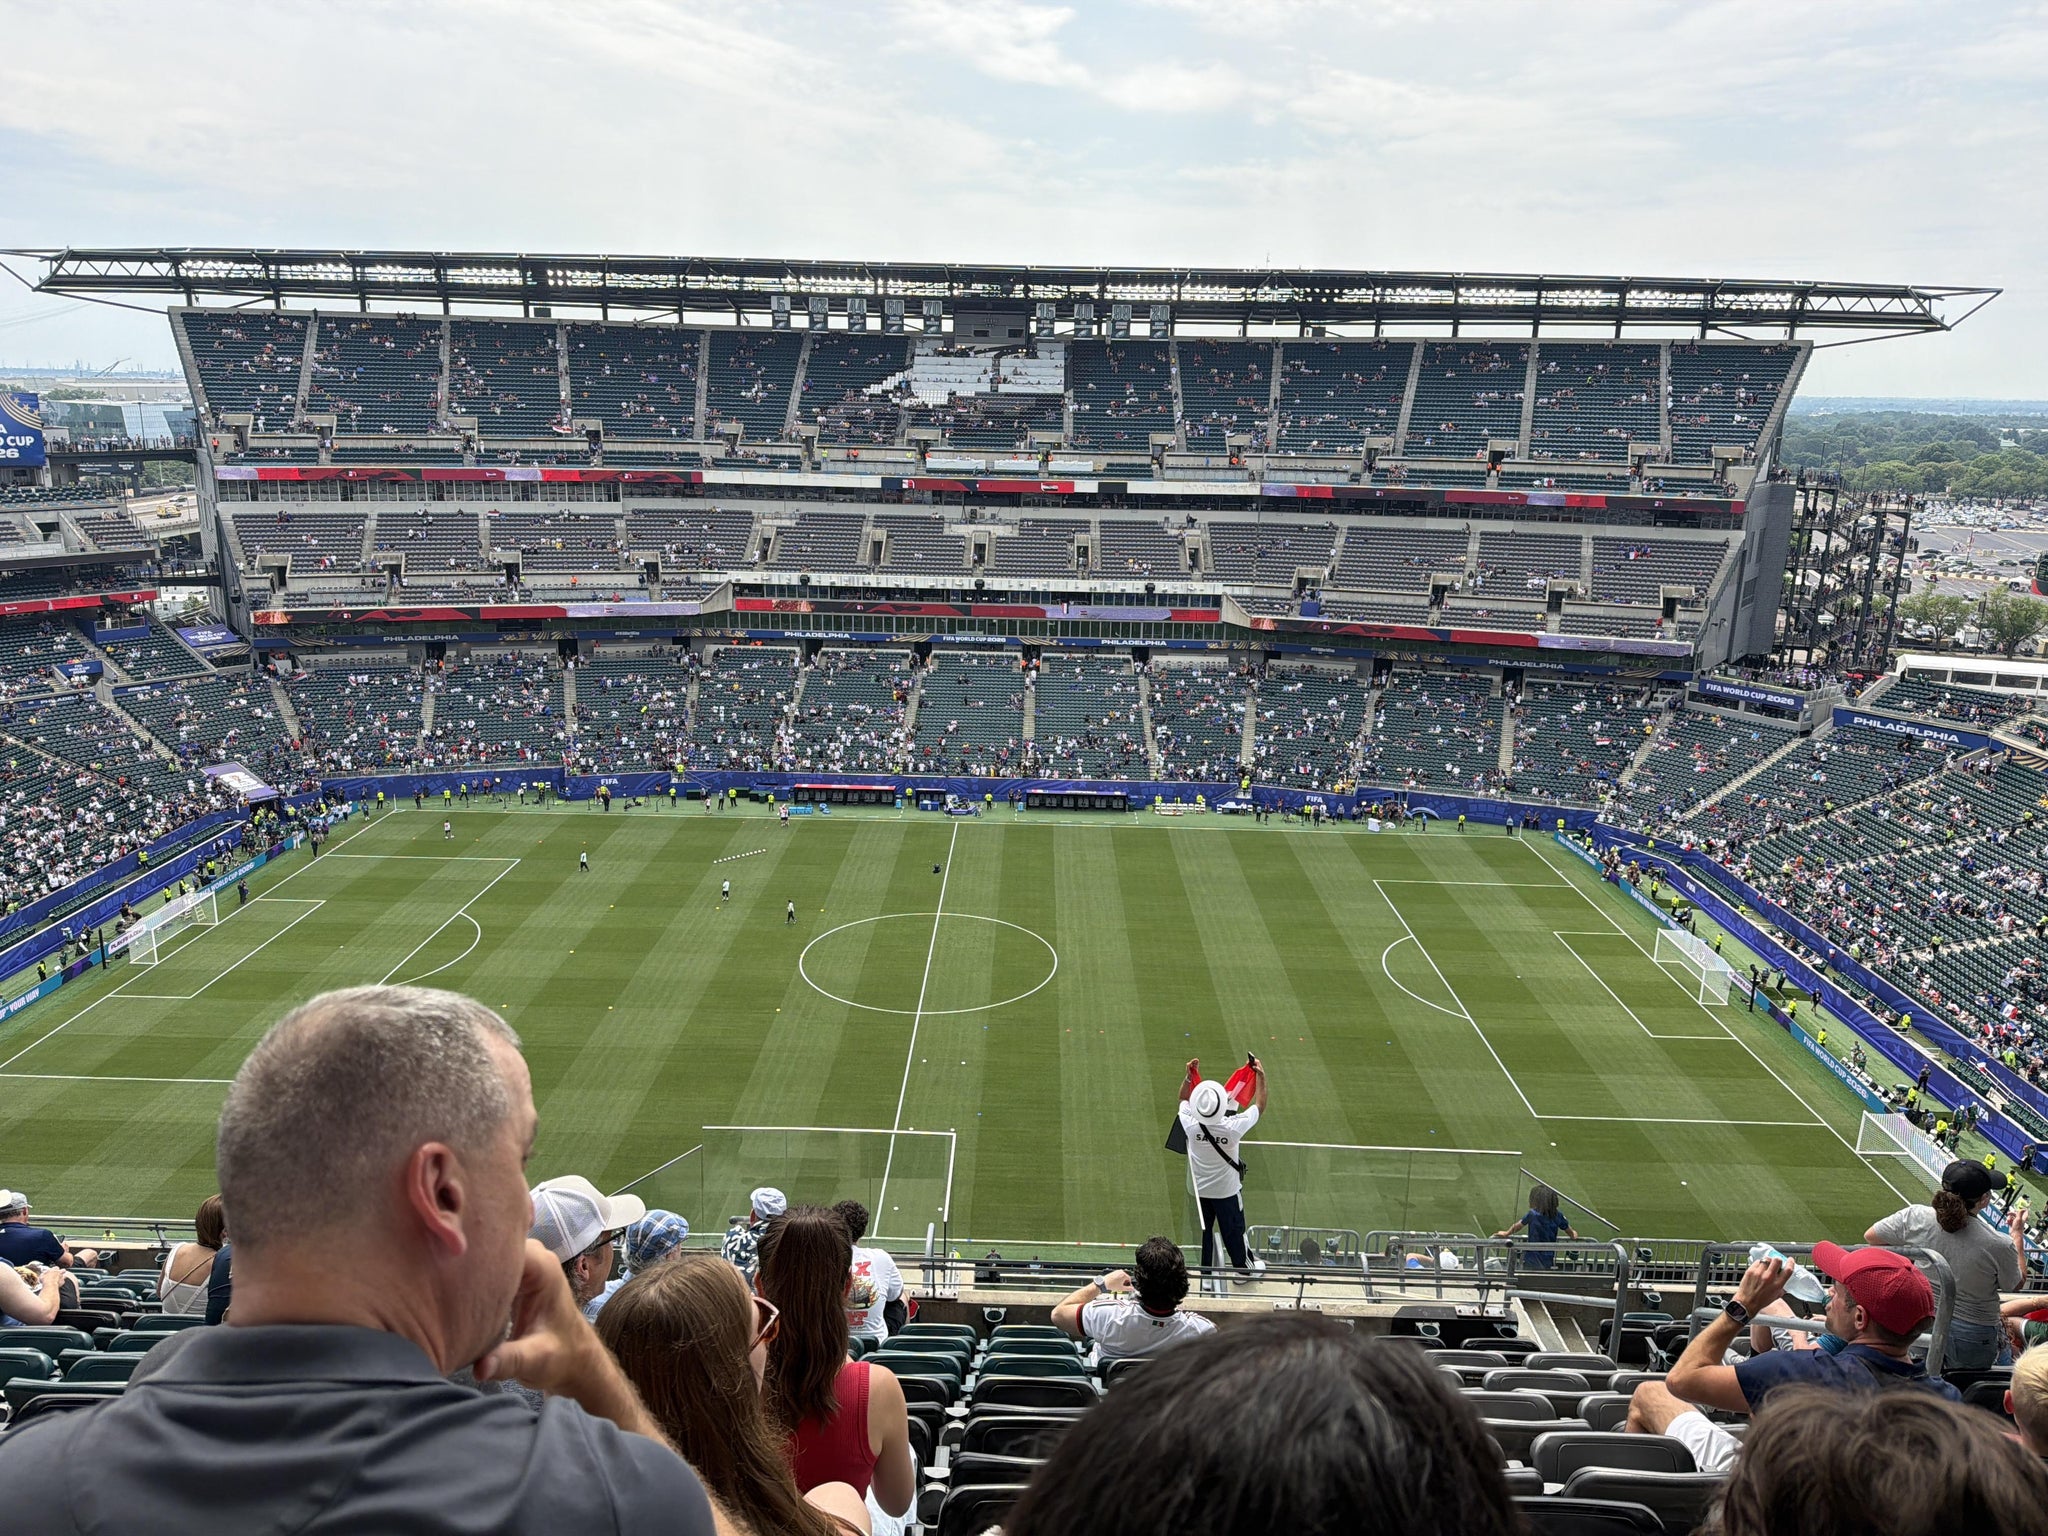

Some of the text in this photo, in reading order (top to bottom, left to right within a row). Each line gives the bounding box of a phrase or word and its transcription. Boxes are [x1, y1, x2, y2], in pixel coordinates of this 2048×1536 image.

[849, 299, 865, 314] 44
[924, 301, 942, 316] 70
[1039, 304, 1055, 319] 15
[7, 436, 35, 447] CUP
[785, 631, 851, 639] PHILADELPHIA
[1101, 639, 1168, 647] PHILADELPHIA
[1488, 659, 1566, 670] PHILADELPHIA
[1706, 683, 1795, 706] FIFA WORLD CUP 2026
[1853, 716, 1960, 743] PHILADELPHIA
[9, 996, 26, 1012] YOUR
[25, 987, 40, 1003] WAY
[1803, 1036, 1816, 1051] FIFA
[1815, 1049, 1835, 1069] WORLD
[1834, 1065, 1847, 1079] CUP
[1195, 1133, 1229, 1145] SAEQ
